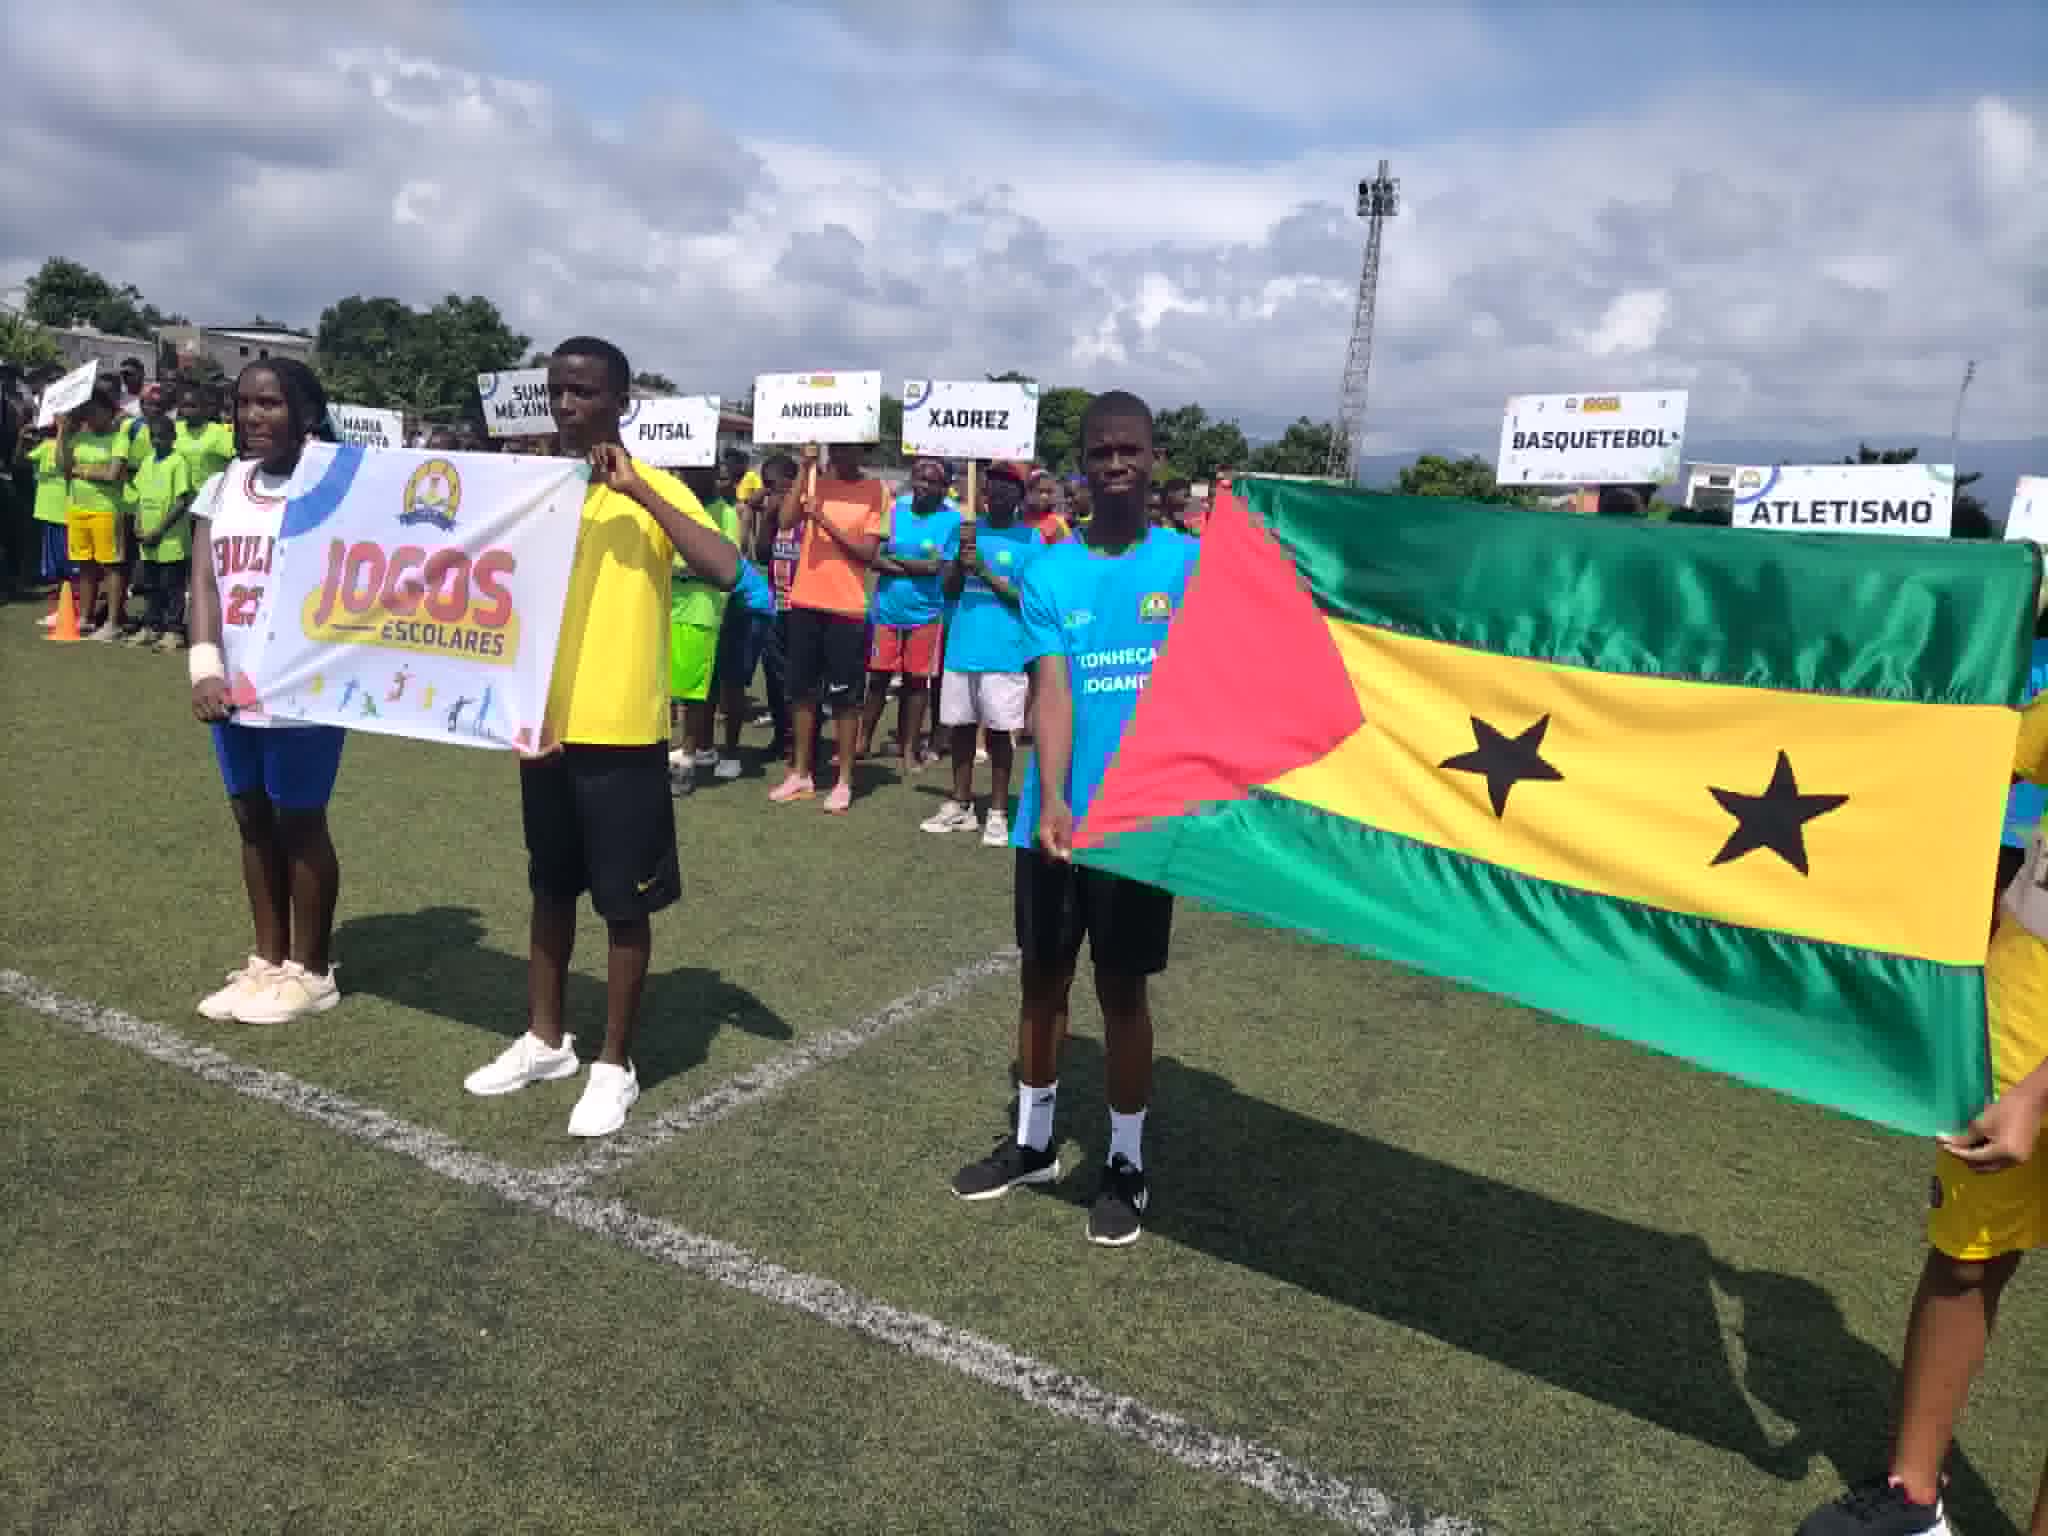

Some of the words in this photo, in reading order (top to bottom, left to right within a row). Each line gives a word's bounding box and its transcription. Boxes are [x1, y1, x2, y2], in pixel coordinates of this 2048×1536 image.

[780, 400, 855, 419] ANDEBOL
[928, 407, 1009, 430] XADREZ
[343, 415, 383, 433] MARIA
[639, 423, 697, 441] FUTSAL
[1512, 428, 1672, 453] BASQUETEBOL
[1750, 500, 1933, 525] ATLETISMO
[313, 537, 517, 628] JOGOS
[380, 620, 506, 657] ESCOLARES
